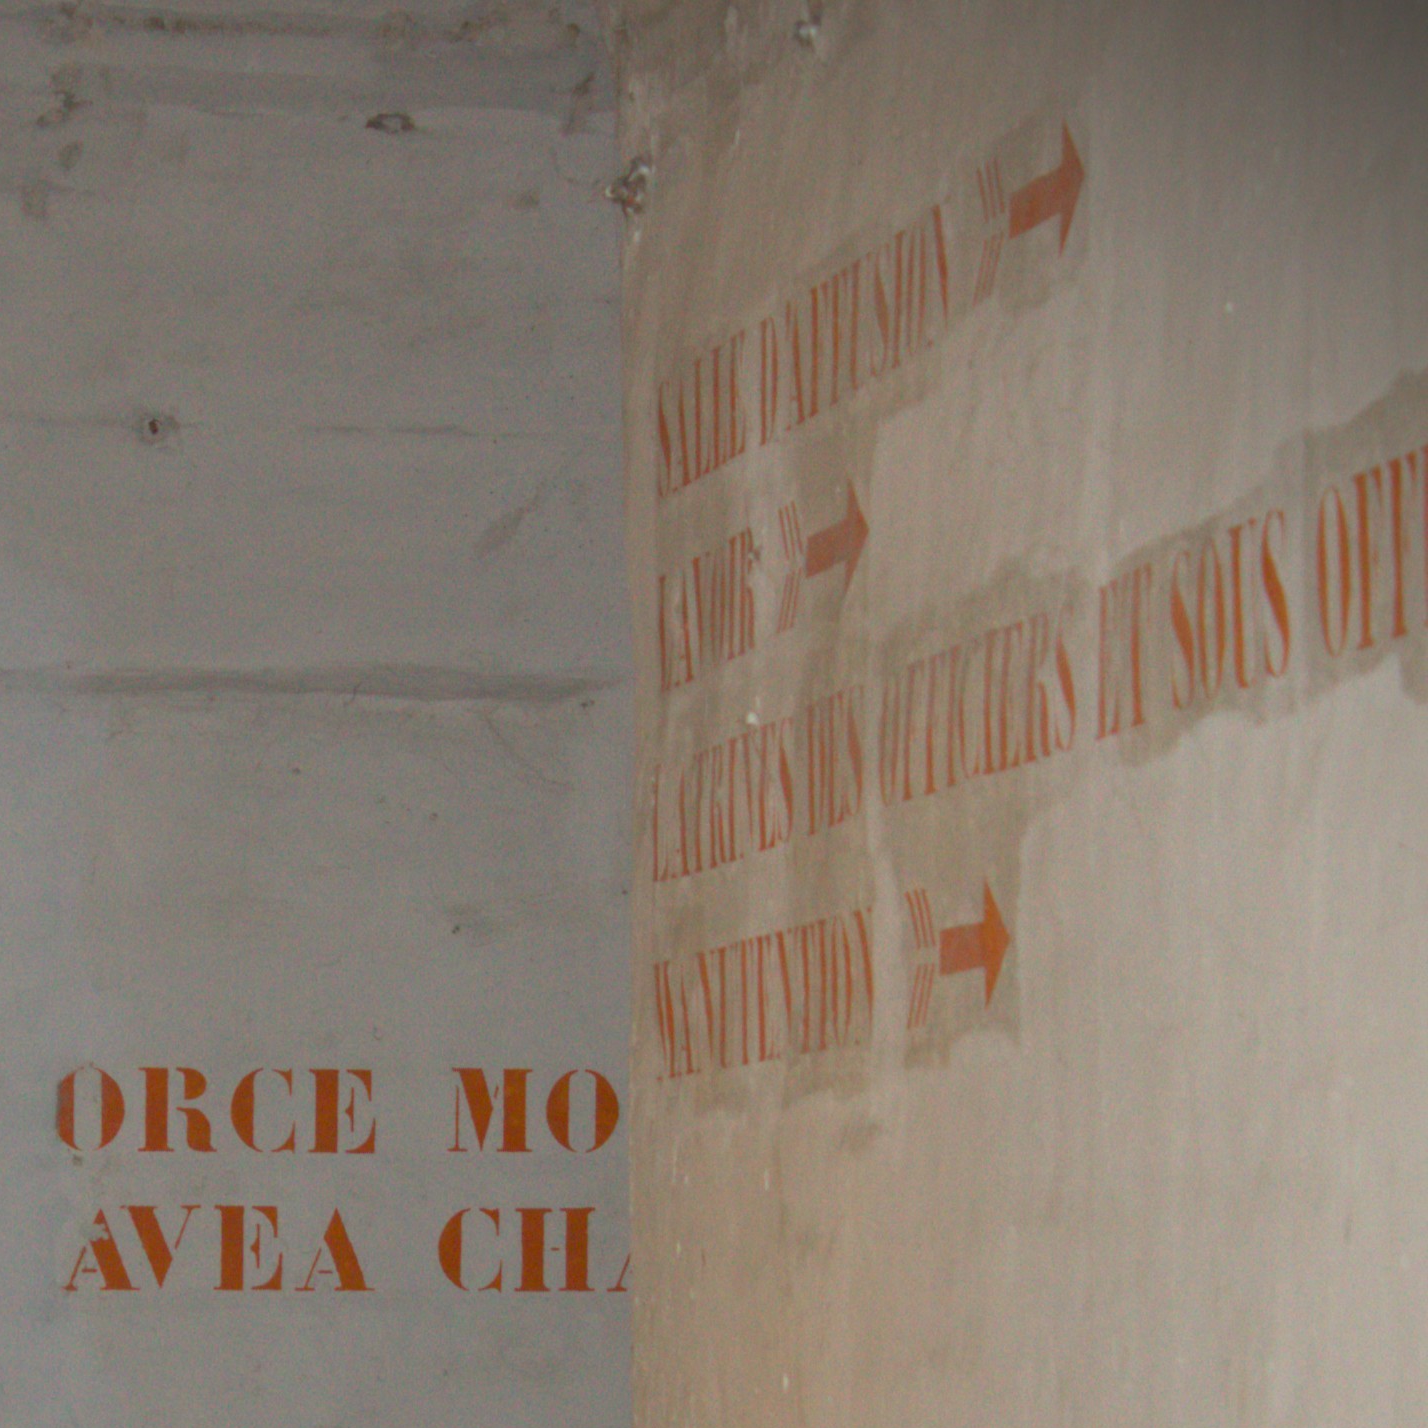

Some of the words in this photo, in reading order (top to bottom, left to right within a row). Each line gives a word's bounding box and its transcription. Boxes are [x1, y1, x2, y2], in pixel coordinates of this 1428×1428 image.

[657, 330, 747, 498] SALLE
[652, 715, 795, 883] LATRINES
[807, 683, 864, 838] DES
[877, 602, 1076, 805] OFFICIERS
[1097, 560, 1153, 740] ET
[1171, 507, 1290, 710] SOUS
[1316, 444, 1428, 658] OFF
[657, 523, 756, 696] LAVOIR
